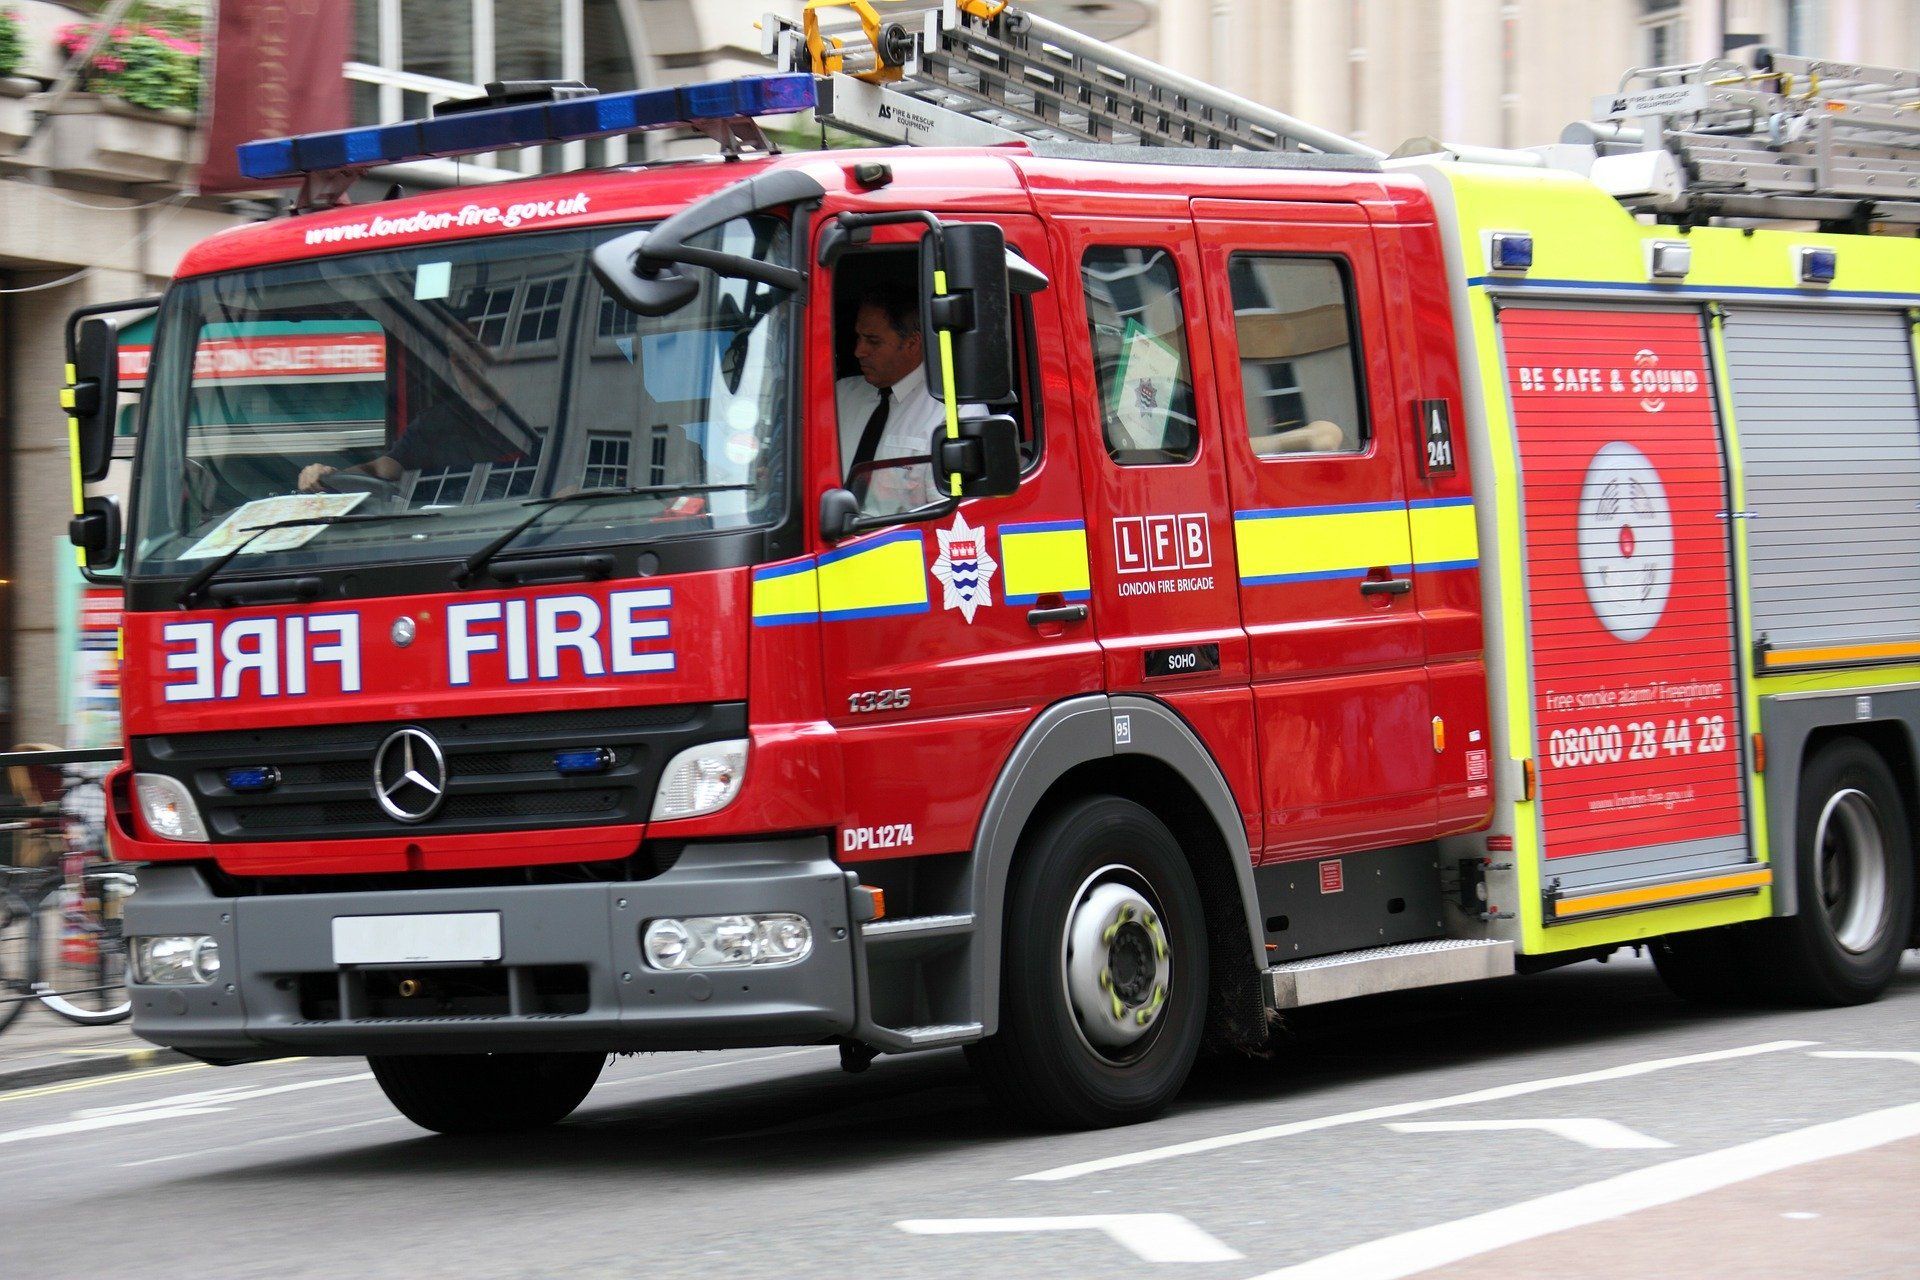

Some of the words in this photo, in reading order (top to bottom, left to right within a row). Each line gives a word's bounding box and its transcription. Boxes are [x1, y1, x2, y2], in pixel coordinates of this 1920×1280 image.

[878, 103, 891, 119] AS
[892, 107, 906, 117] FIRE
[911, 113, 935, 127] RESCUE
[897, 116, 930, 133] EQUIPMENT
[304, 192, 591, 245] www.london-fire.gov.uk
[252, 346, 311, 369] SALE
[315, 344, 382, 368] HERE
[1518, 367, 1546, 392] BE
[1552, 367, 1603, 392] SAFE
[1610, 368, 1625, 392] &
[1630, 369, 1699, 393] SOUND
[1432, 409, 1442, 434] A
[1427, 440, 1452, 467] 241
[1118, 580, 1156, 597] LONDON
[1157, 579, 1175, 594] FIRE
[1177, 576, 1214, 592] BRIGADE
[446, 587, 676, 686] FIRE
[1168, 652, 1196, 670] SOHO
[848, 687, 912, 713] 1325
[1546, 690, 1574, 713] Free
[1576, 685, 1617, 711] smoke
[1619, 682, 1657, 706] alarm?
[1659, 678, 1723, 709] Freephone
[1116, 722, 1128, 737] 95
[1550, 724, 1623, 768] 08000
[1626, 721, 1658, 761] 28
[1662, 718, 1692, 756] 44
[1695, 715, 1727, 752] 28
[843, 823, 914, 852] DPL1274
